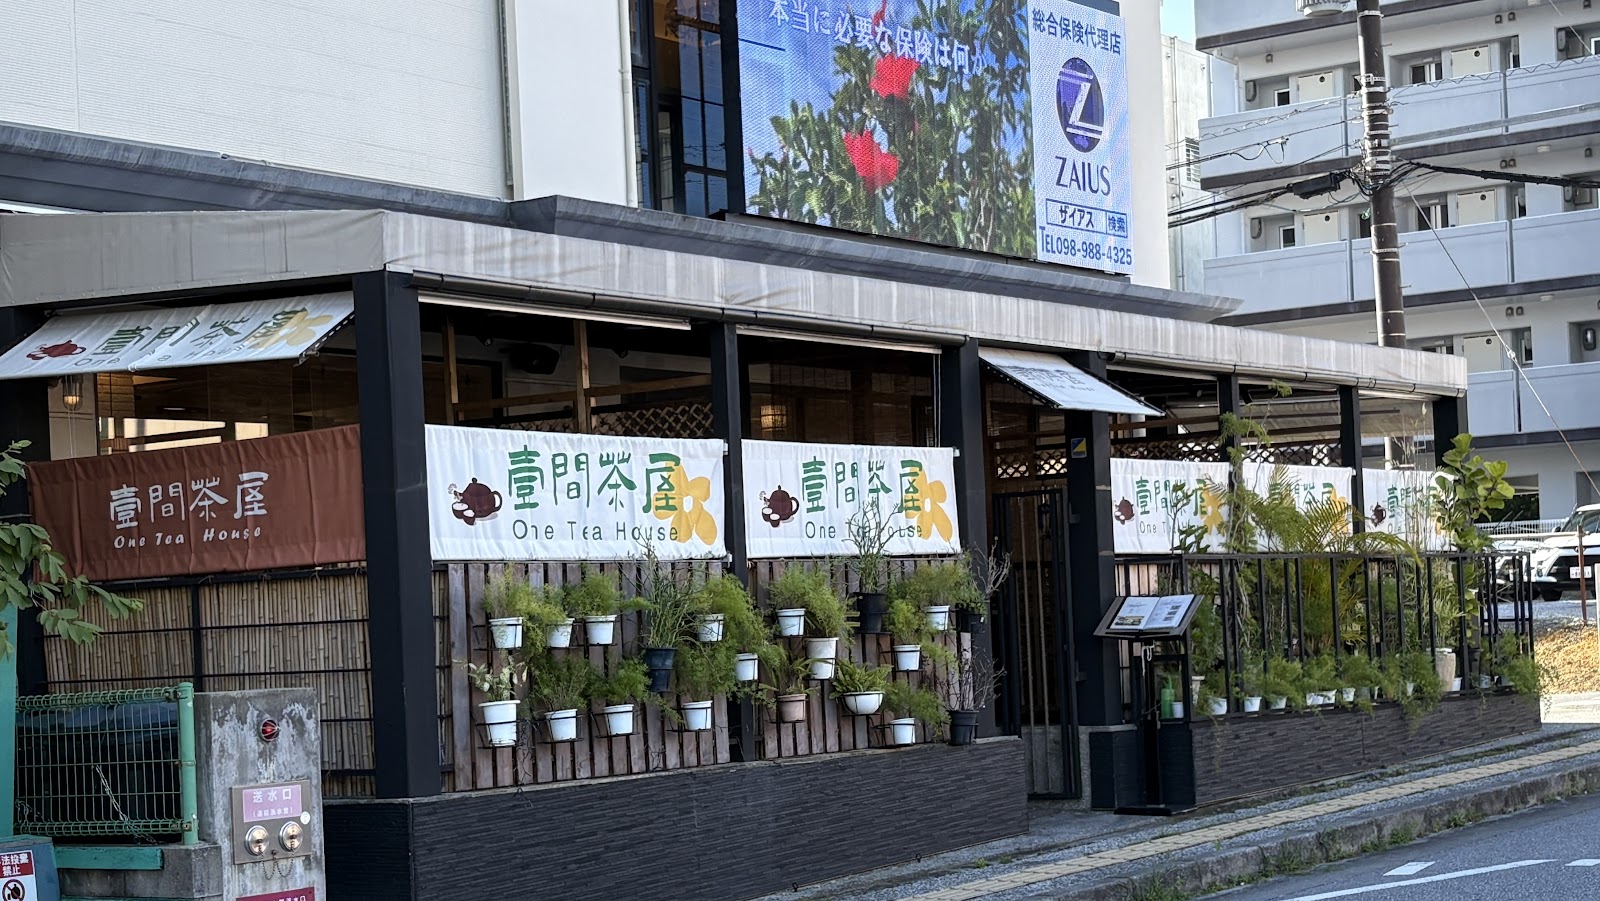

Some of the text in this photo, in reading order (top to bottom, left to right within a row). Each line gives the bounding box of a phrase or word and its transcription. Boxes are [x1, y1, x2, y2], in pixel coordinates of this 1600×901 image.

[1032, 7, 1121, 56] 総合保険代理店
[1055, 156, 1111, 196] ZAIUS
[1059, 205, 1094, 228] ザイアス
[1108, 216, 1126, 233] 検索
[513, 519, 678, 541] One Tea House
[805, 521, 836, 539] One
[1140, 520, 1157, 534] One
[114, 526, 261, 549] One Tea House
[253, 788, 292, 803] 送水口
[0, 853, 29, 866] 法投棄
[3, 864, 22, 877] 禁止
